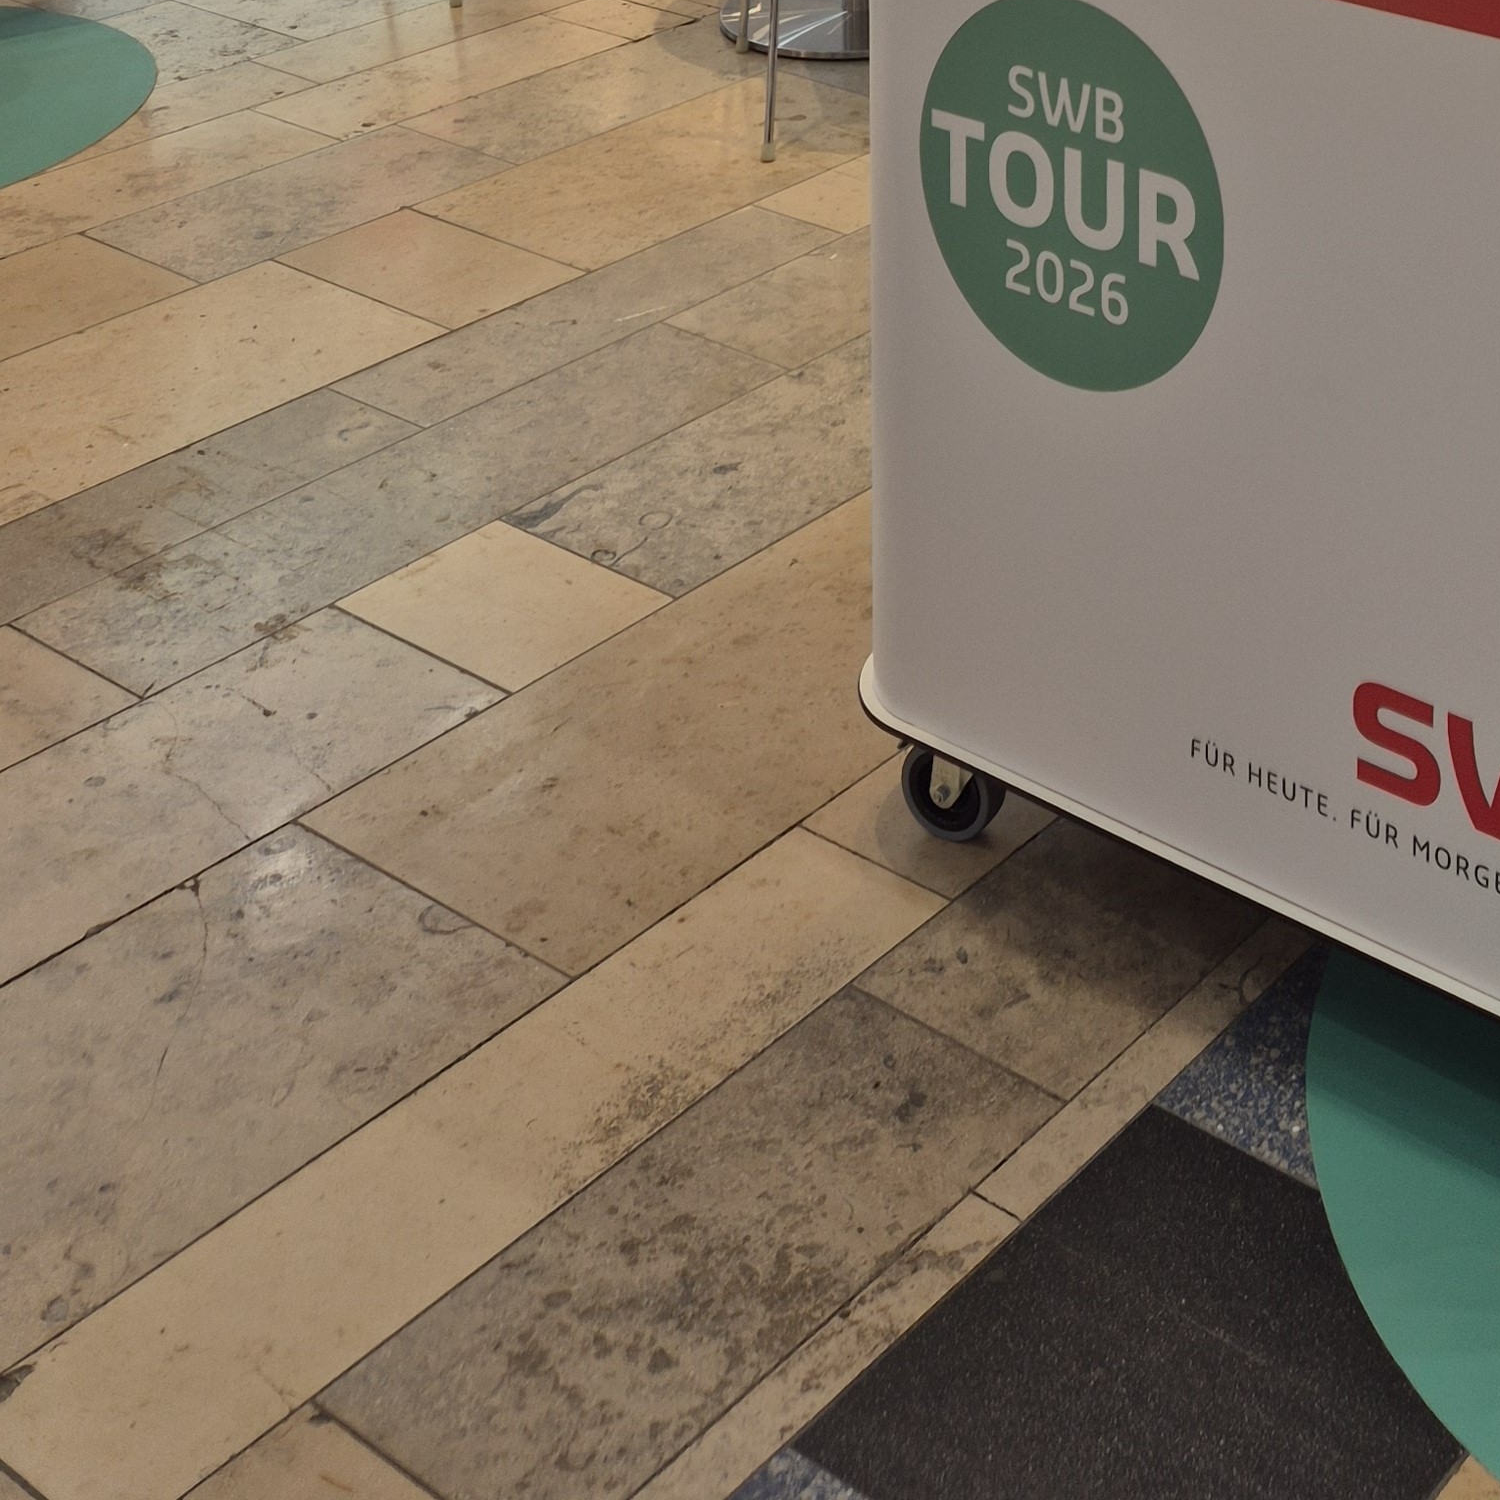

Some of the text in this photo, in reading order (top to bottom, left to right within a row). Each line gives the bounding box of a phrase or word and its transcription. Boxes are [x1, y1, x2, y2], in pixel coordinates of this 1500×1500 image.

[1008, 64, 1125, 144] SWB
[931, 108, 1200, 281] TOUR
[1005, 238, 1129, 326] 2026
[1190, 738, 1236, 776] FÜR
[1248, 762, 1337, 822] HEUTE.
[1350, 808, 1399, 849] FÜR
